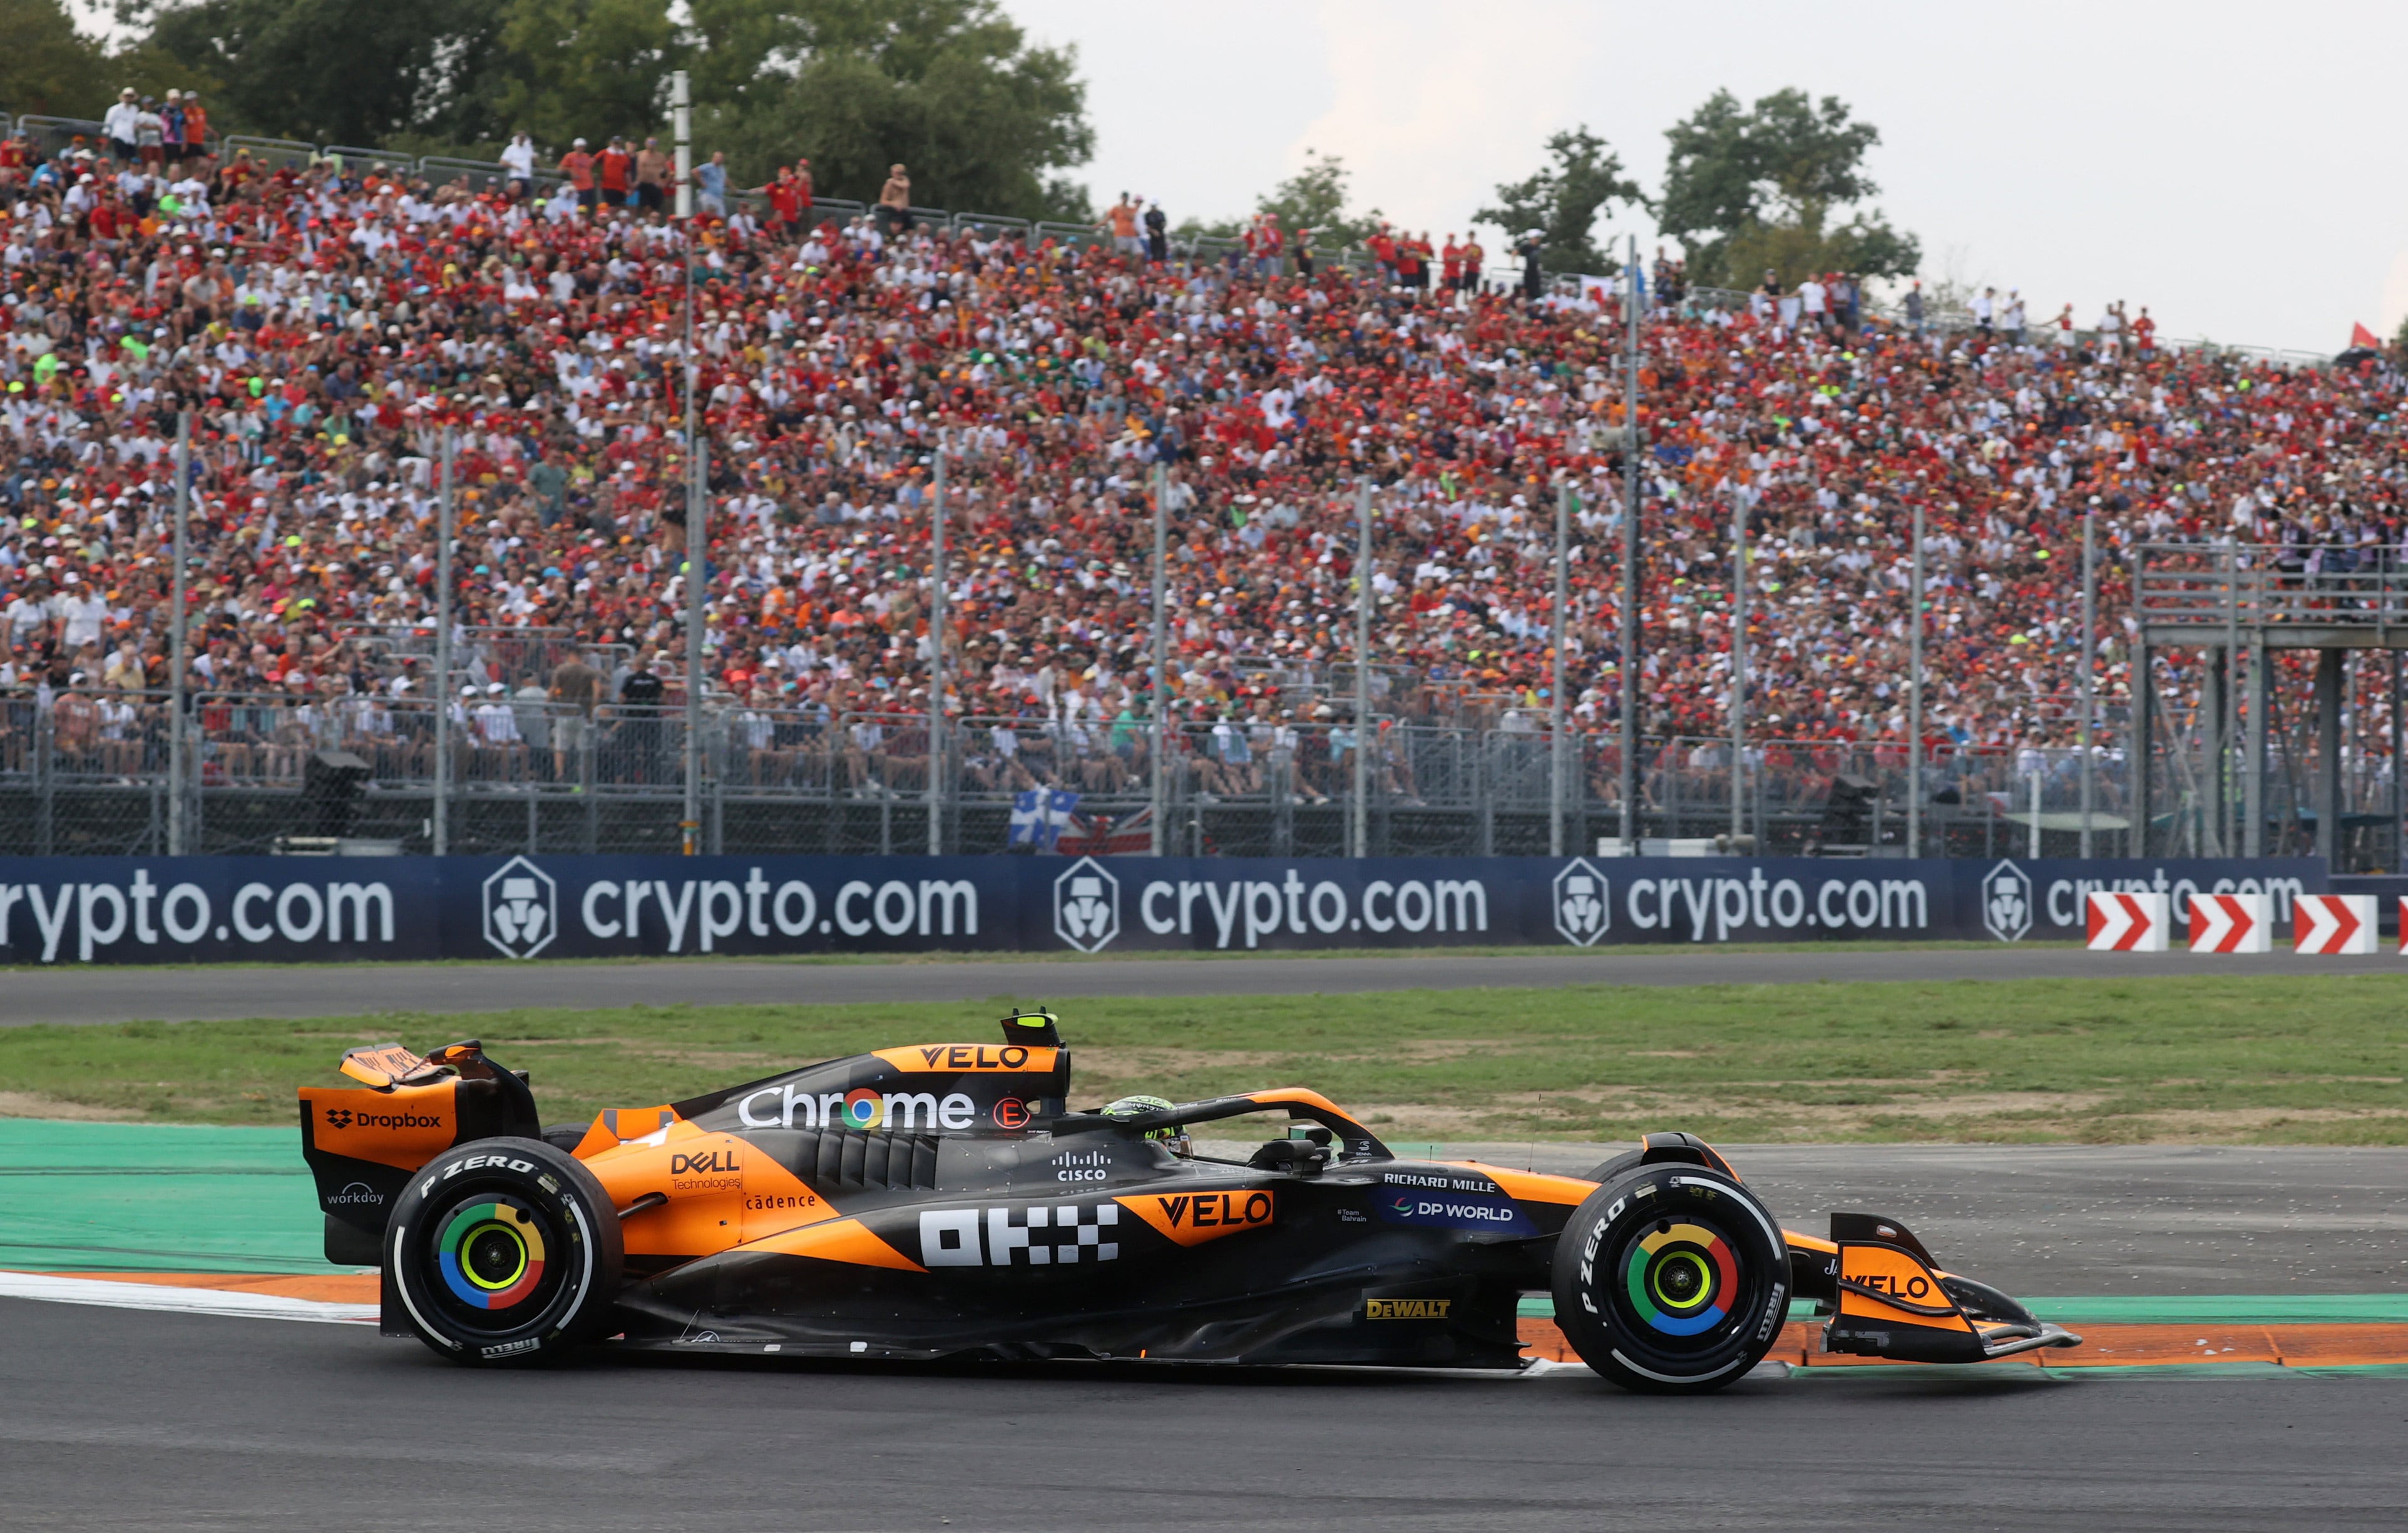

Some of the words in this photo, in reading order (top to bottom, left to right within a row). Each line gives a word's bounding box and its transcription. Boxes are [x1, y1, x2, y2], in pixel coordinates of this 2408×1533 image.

[0, 868, 394, 962] rypto.com
[581, 866, 978, 953] crypto.com
[1140, 868, 1488, 948] crypto.com
[1627, 866, 1928, 941] crypto.com
[919, 1045, 1028, 1069] VELO
[357, 1112, 441, 1131] Dropbox
[737, 1084, 975, 1130] Chrome
[420, 1175, 436, 1199] P
[443, 1155, 535, 1181] ZERO
[671, 1151, 740, 1175] DELL
[327, 1191, 384, 1206] workday
[671, 1176, 741, 1190] Technologies
[1384, 1172, 1448, 1188] RICHARD
[1452, 1179, 1495, 1192] MILLE
[1157, 1192, 1272, 1229] VELO
[1341, 1214, 1367, 1223] Bahrain
[1418, 1201, 1444, 1216] DP
[1445, 1203, 1514, 1222] WORLD
[919, 1204, 1119, 1267] OKX
[1581, 1196, 1626, 1287] ZERO
[1581, 1291, 1599, 1314] P
[1756, 1281, 1785, 1342] PIRELLI
